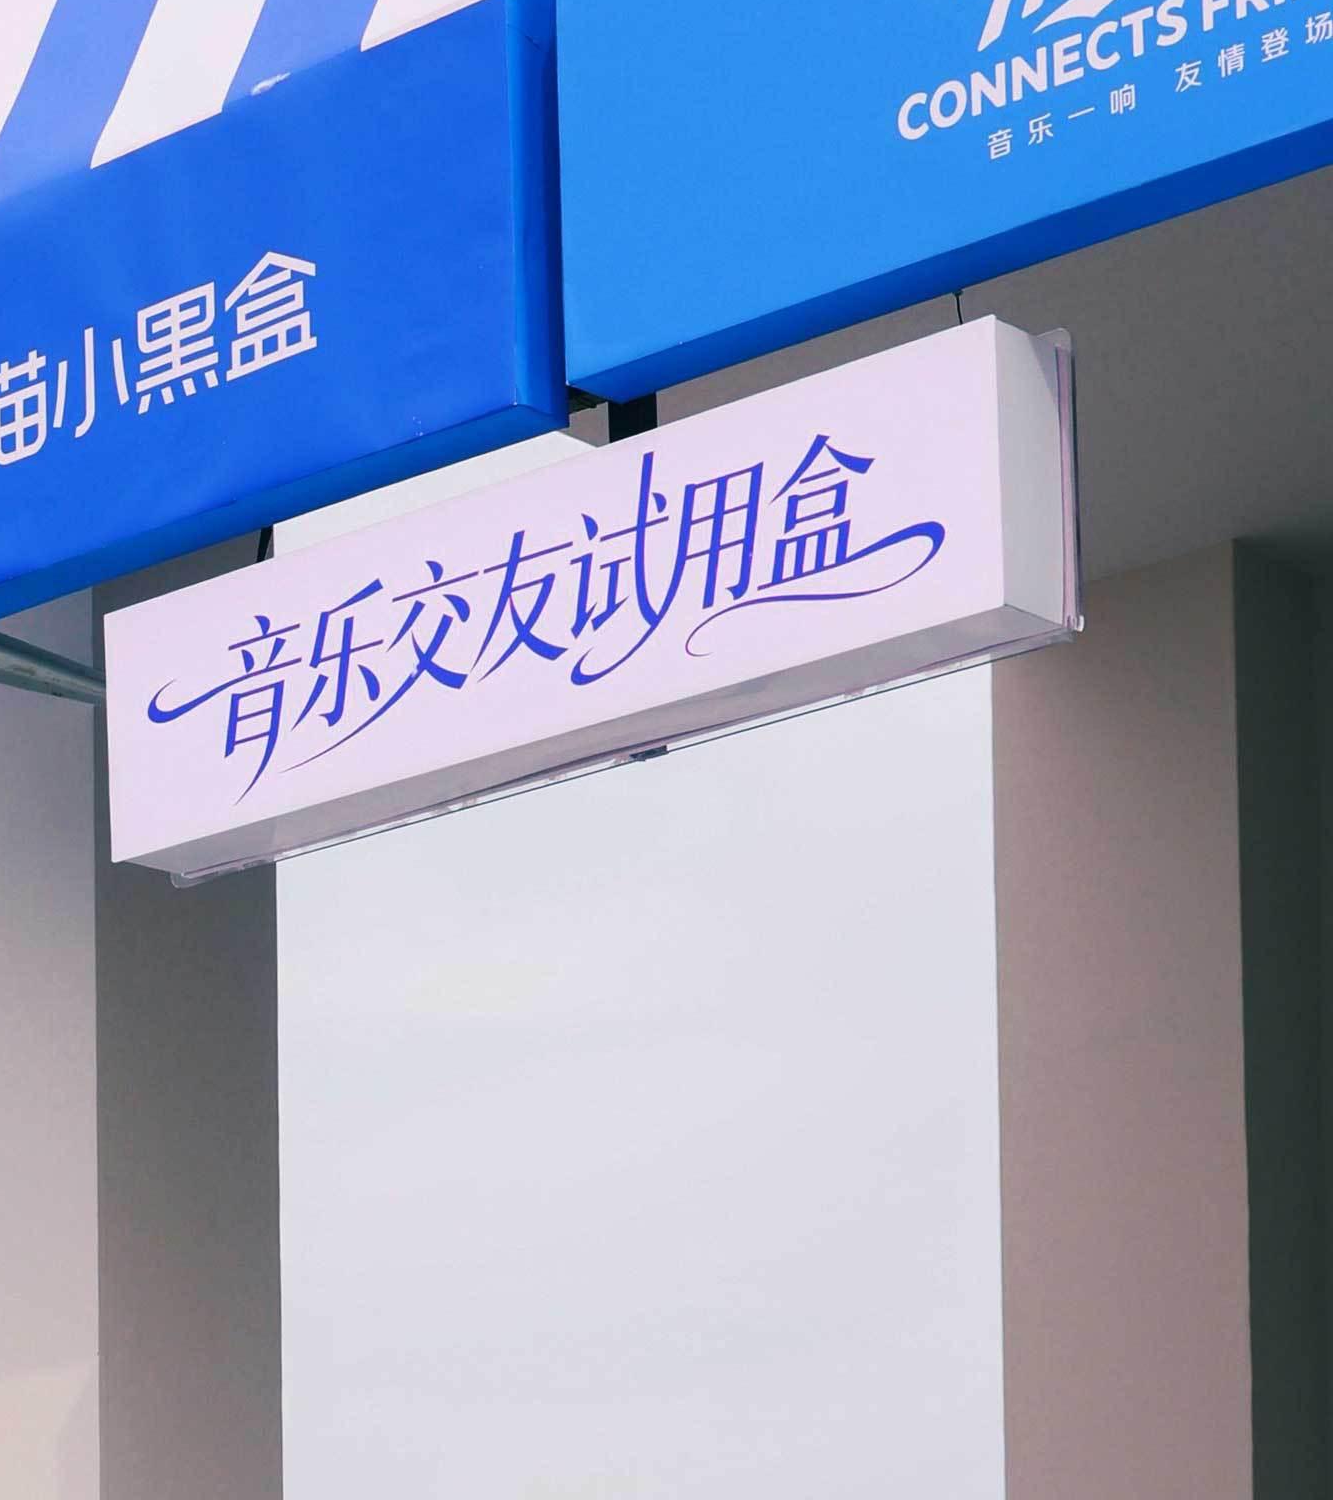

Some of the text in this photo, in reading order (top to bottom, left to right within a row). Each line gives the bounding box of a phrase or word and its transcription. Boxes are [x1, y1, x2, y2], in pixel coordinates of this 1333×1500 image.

[986, 85, 1136, 161] 音乐一响
[147, 433, 945, 806] 音乐交友试用盒
